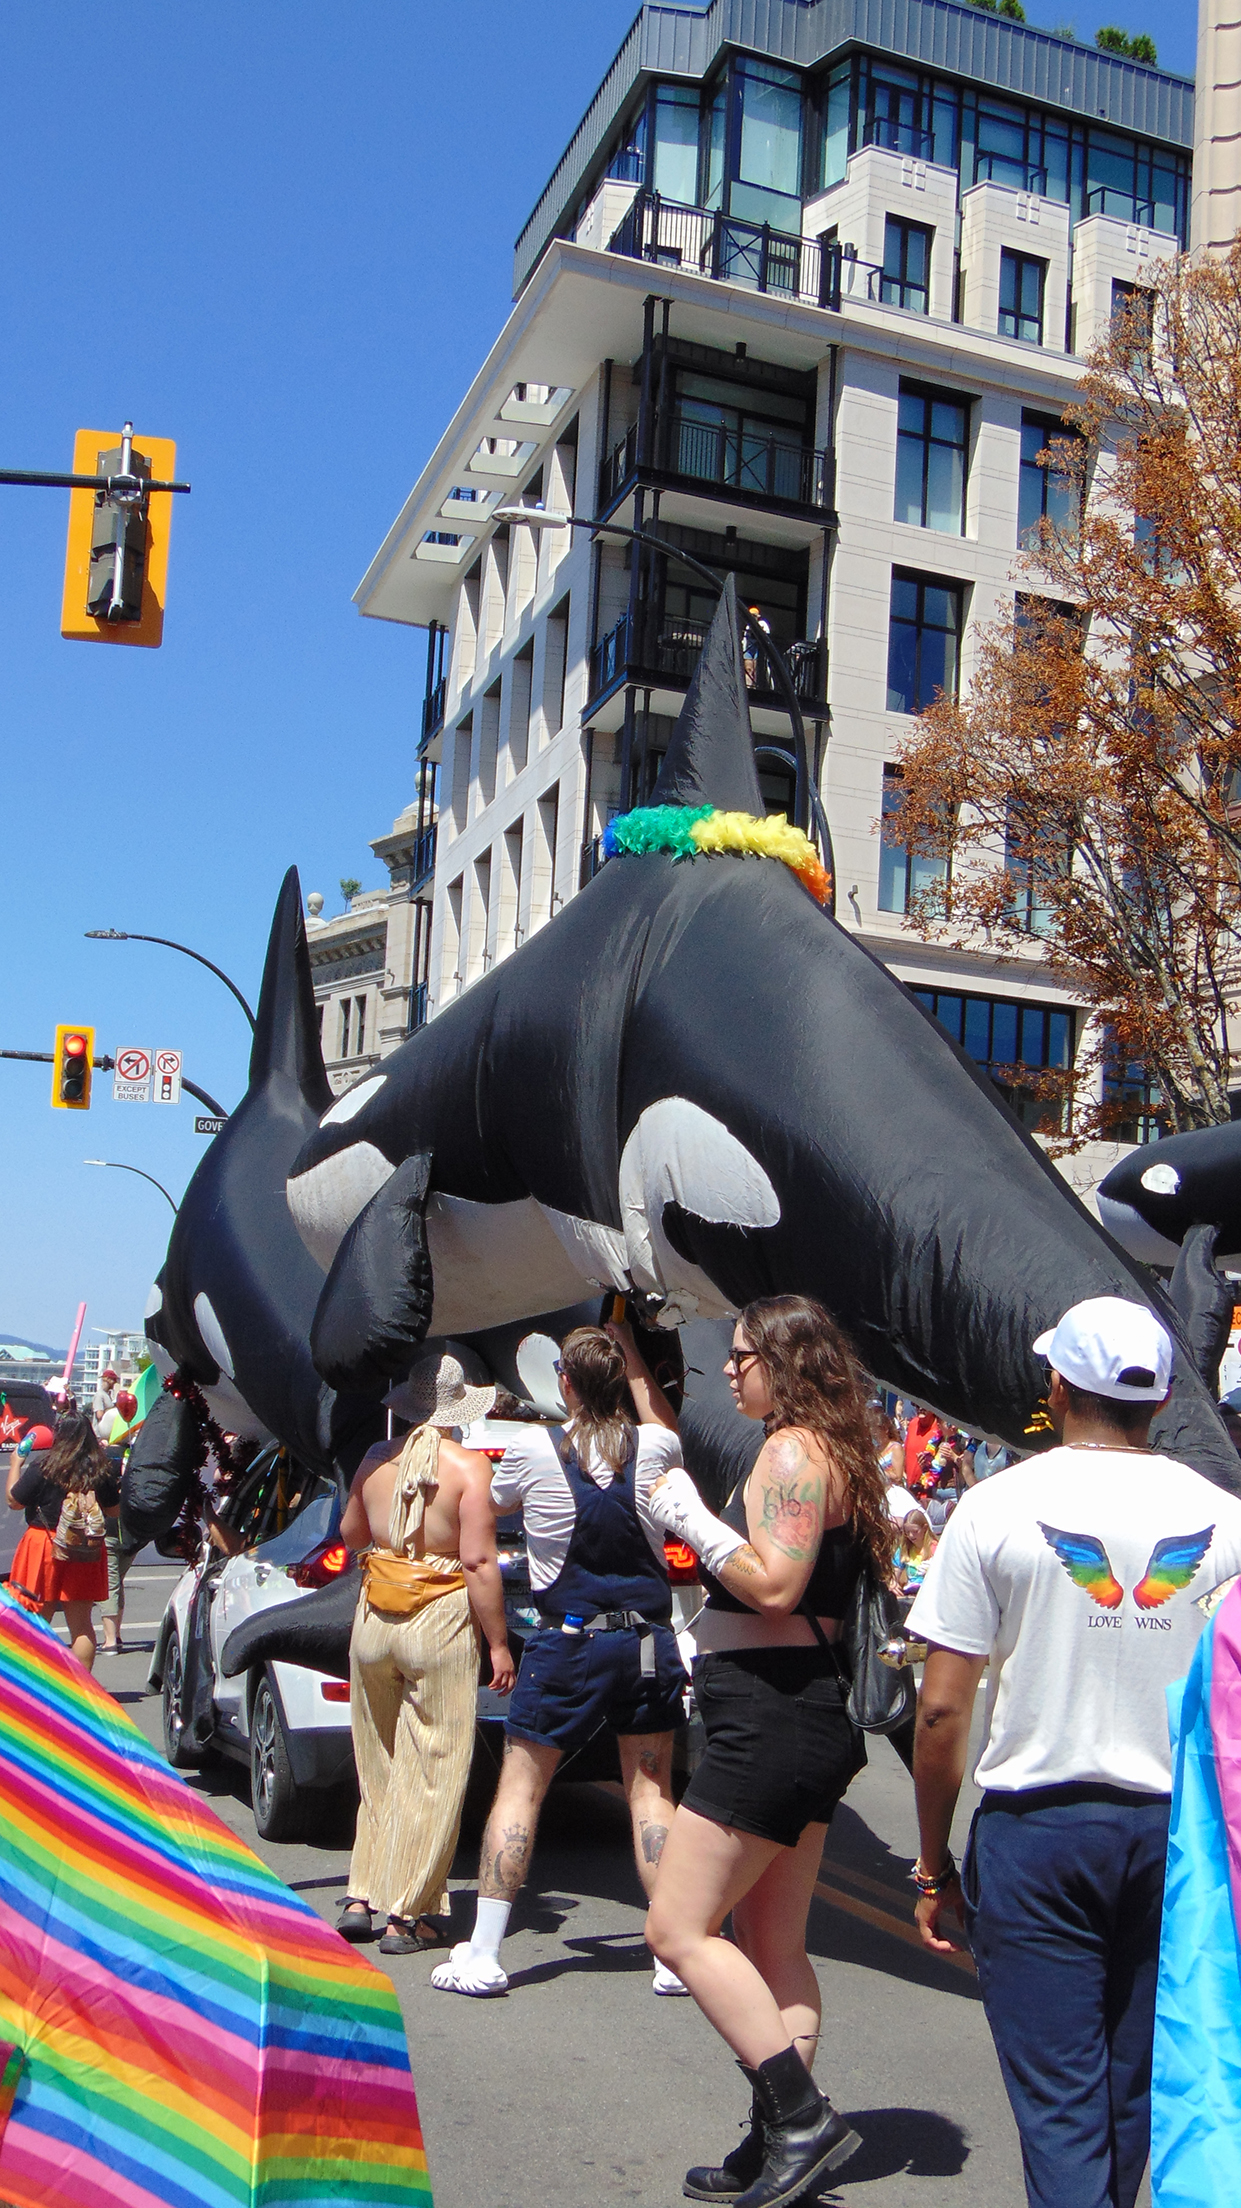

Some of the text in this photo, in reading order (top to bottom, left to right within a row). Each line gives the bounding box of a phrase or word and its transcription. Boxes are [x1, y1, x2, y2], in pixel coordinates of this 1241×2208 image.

[116, 1085, 147, 1094] EXCEPT
[117, 1093, 145, 1101] BUSES
[197, 1120, 226, 1132] GOVE
[1088, 1615, 1172, 1630] LOVE WINS
